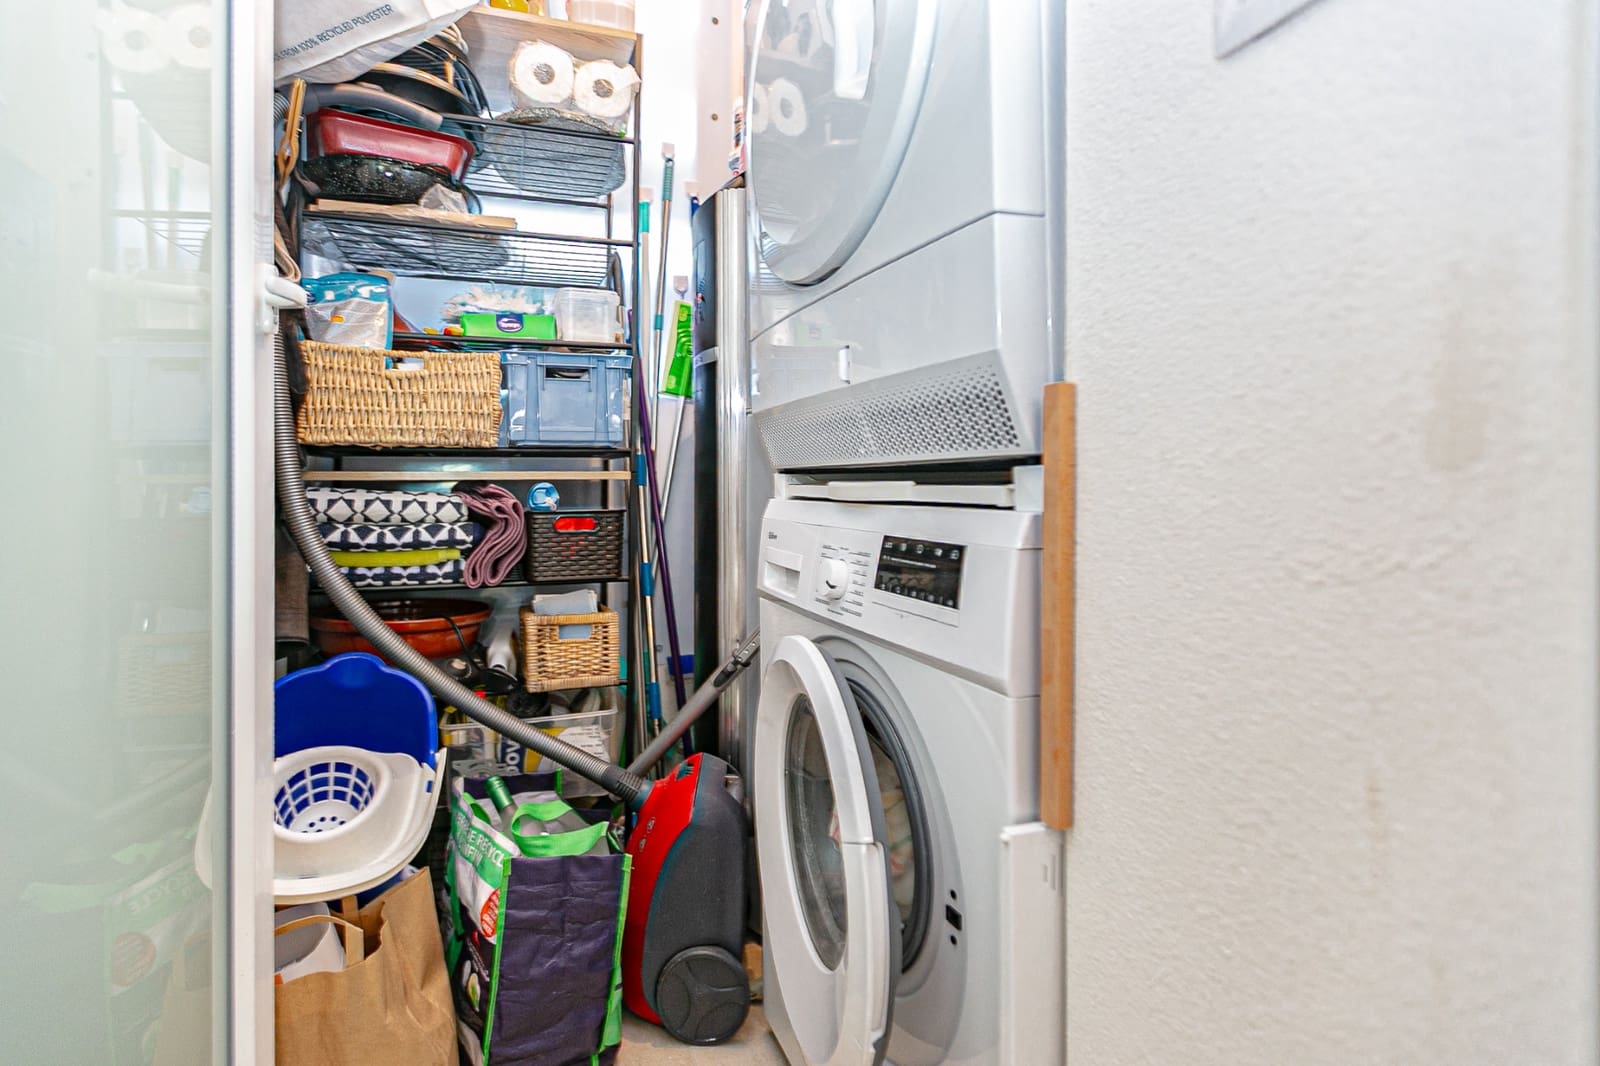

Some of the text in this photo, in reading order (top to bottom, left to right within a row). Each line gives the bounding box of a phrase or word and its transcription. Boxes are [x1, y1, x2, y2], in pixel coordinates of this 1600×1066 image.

[298, 37, 320, 53] 100%
[316, 21, 355, 43] RECYCLED
[352, 4, 394, 28] POLYESTER
